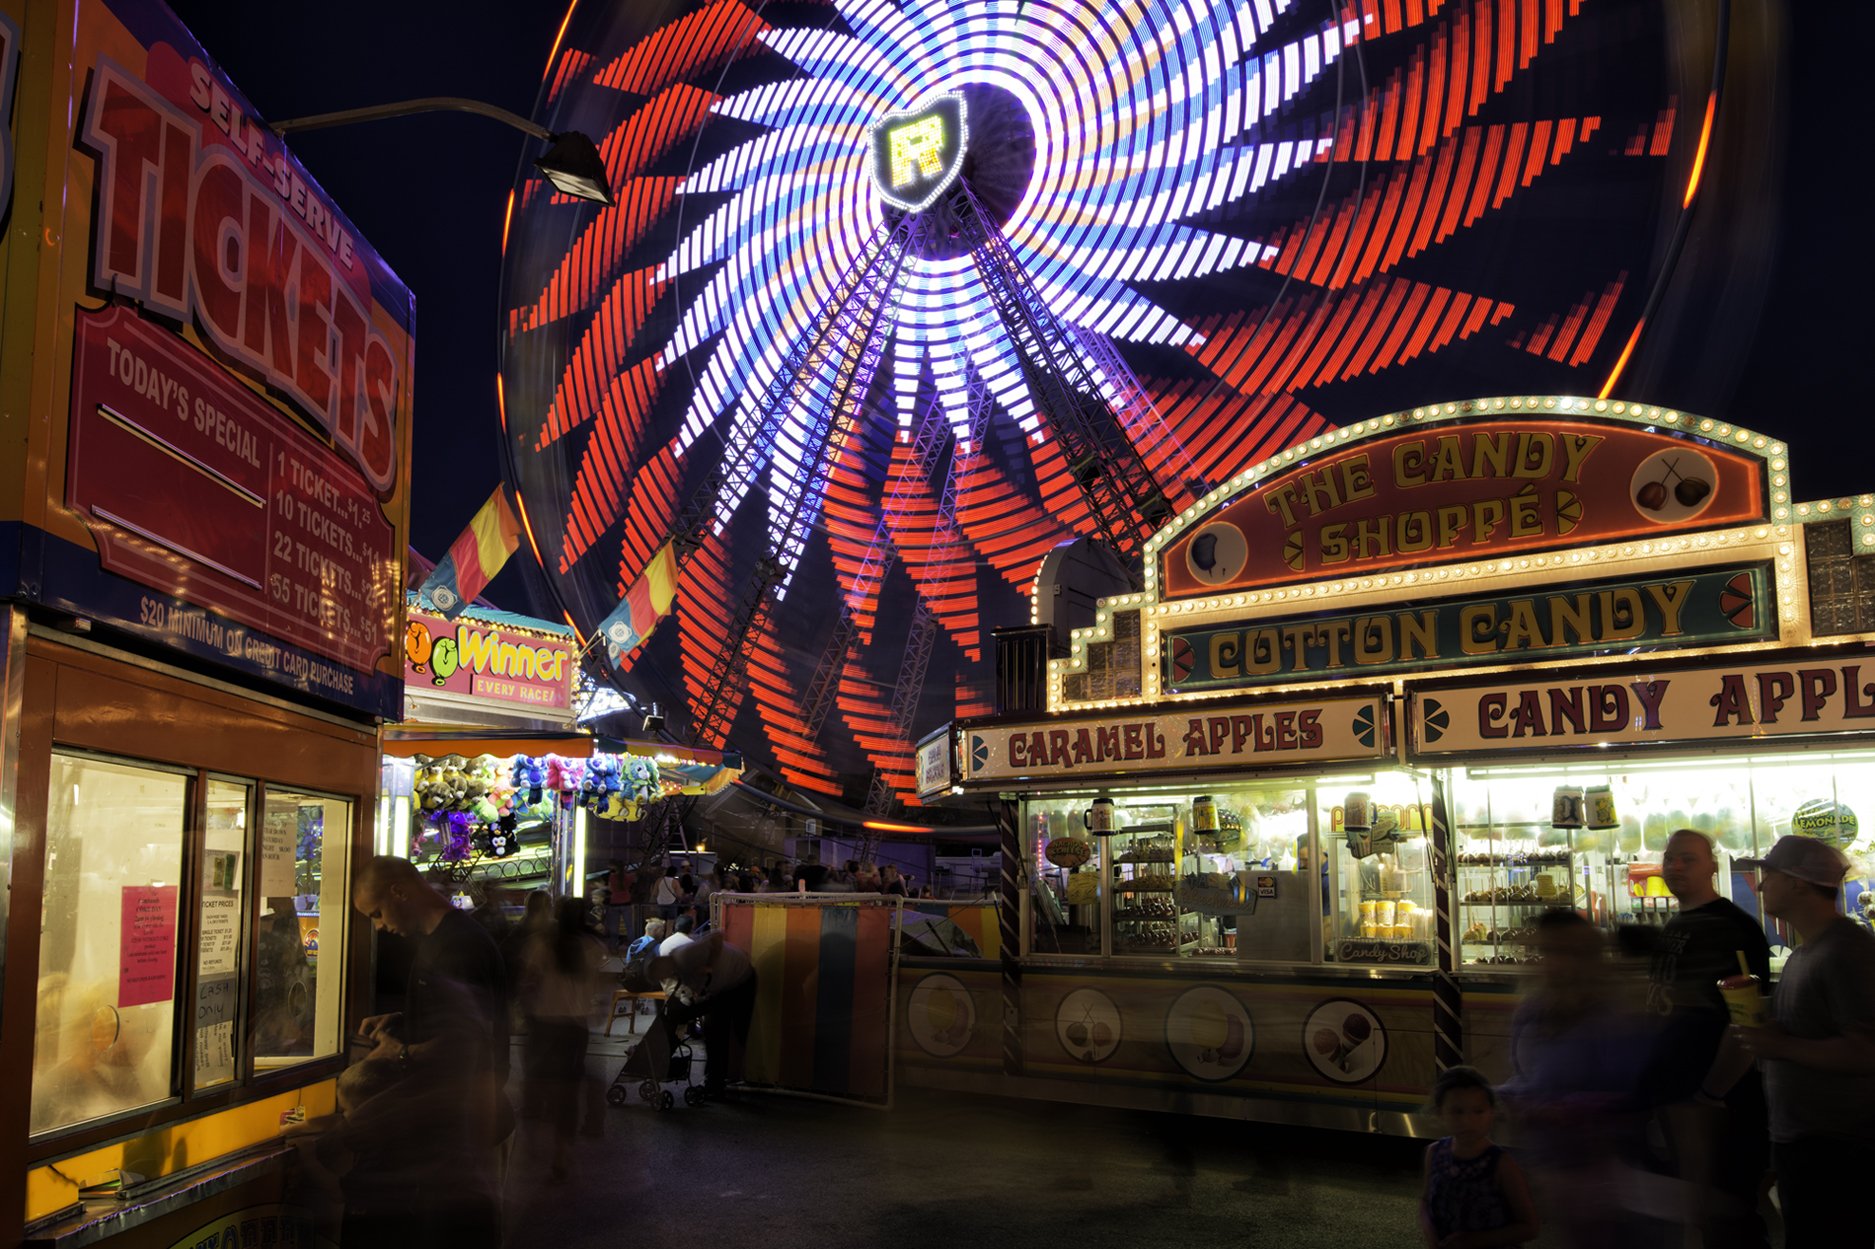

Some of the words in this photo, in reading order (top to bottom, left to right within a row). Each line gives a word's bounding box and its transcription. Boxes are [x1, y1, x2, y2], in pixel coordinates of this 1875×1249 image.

[189, 61, 354, 270] SELF-SERVE
[889, 115, 943, 188] R
[84, 56, 398, 491] TICKETS
[106, 337, 189, 422] TODAY'S
[194, 397, 261, 469] SPECIAL
[276, 489, 294, 521] 10
[1263, 452, 1377, 529] THE
[1393, 431, 1606, 488] CANDY
[273, 530, 293, 563] 22
[1320, 483, 1545, 565] SHOPPÉ
[272, 573, 291, 603] 55
[140, 595, 165, 628] $20
[167, 606, 224, 650] MINIMUM
[226, 629, 243, 656] ON
[245, 638, 281, 670] CREDIT
[283, 651, 308, 681] CARD
[309, 660, 354, 695] PURCHASE
[458, 625, 569, 682] Winner
[1208, 608, 1441, 680] COTTON
[1459, 579, 1698, 655] CANDY
[477, 679, 516, 697] EVERY
[519, 685, 556, 702] RACE!
[1478, 679, 1671, 740] CANDY
[1009, 722, 1166, 769] CARAMEL
[1183, 708, 1324, 758] APPLES
[1340, 942, 1389, 962] Candy
[1388, 944, 1427, 963] Shop
